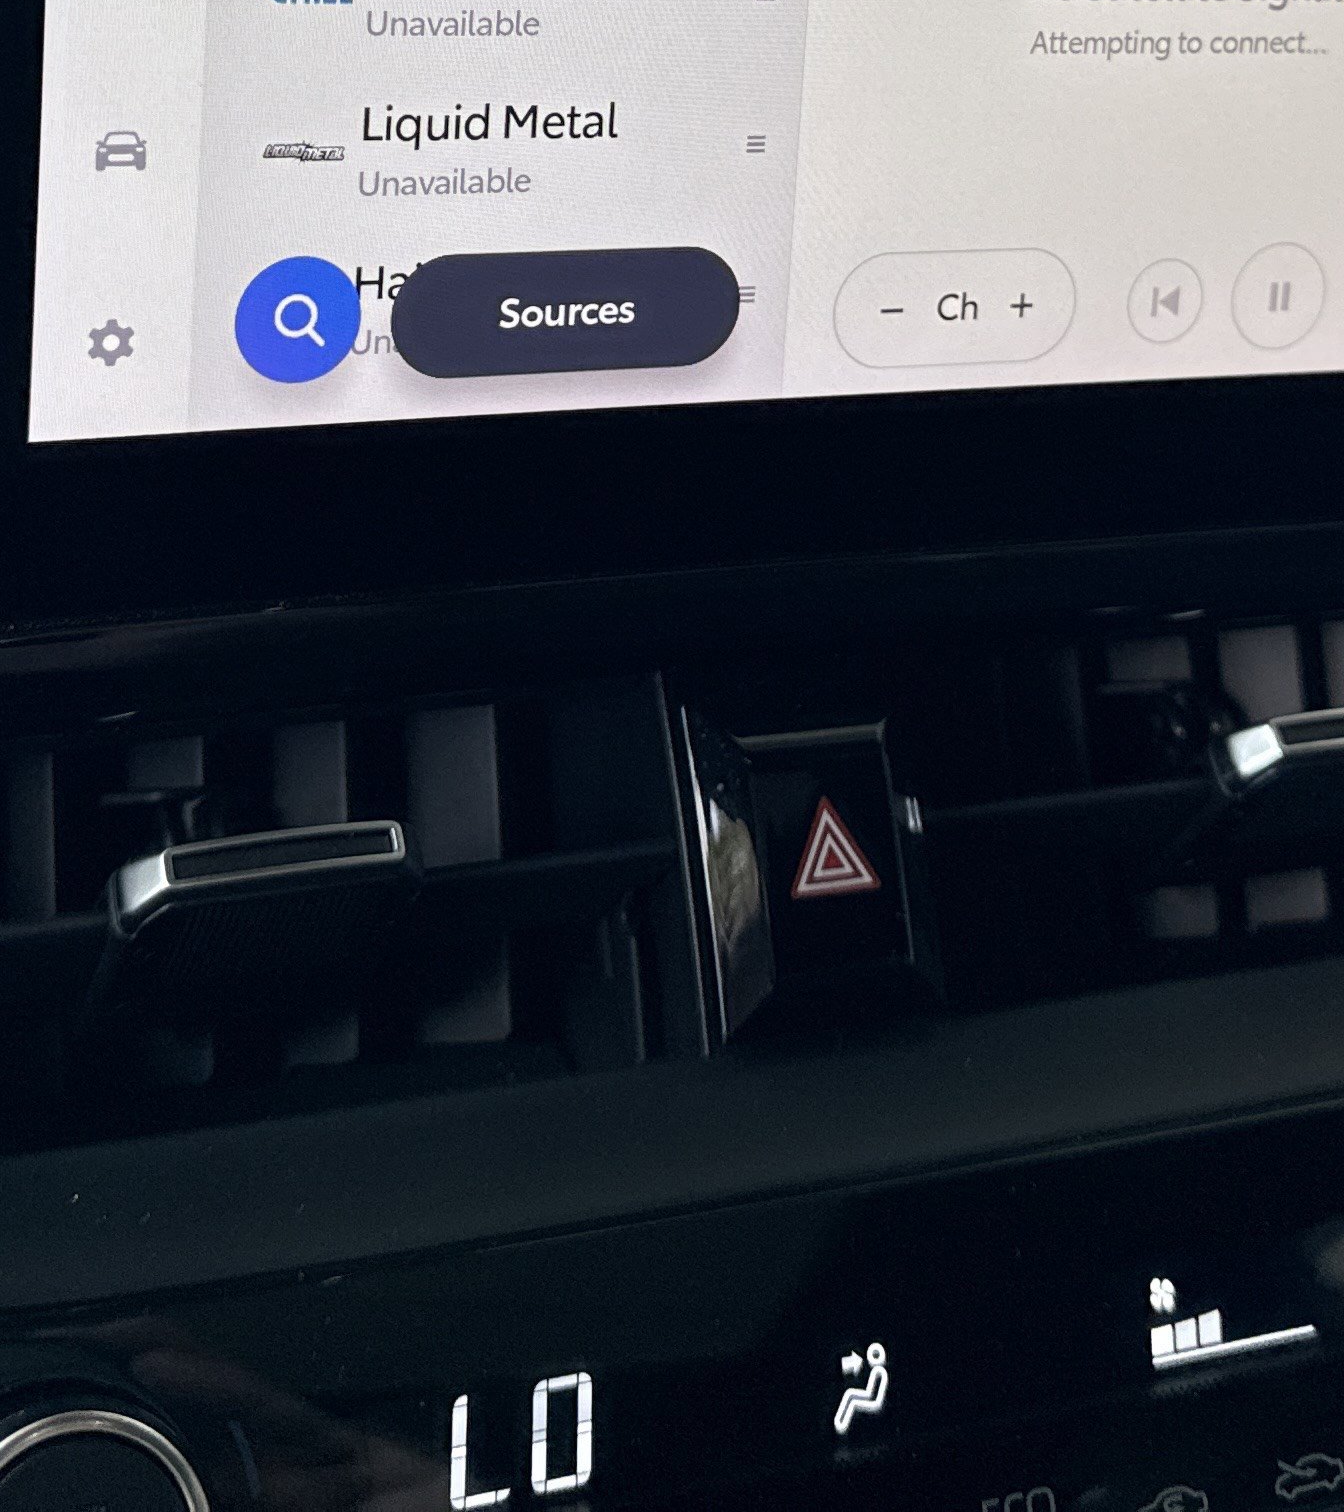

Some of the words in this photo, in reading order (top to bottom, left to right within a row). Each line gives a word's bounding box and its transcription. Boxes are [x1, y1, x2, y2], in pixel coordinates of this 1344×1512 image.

[367, 10, 540, 36] Unavailable
[1030, 30, 1171, 61] Attempting
[1178, 32, 1203, 54] to
[1210, 32, 1328, 54] connect...
[363, 103, 490, 150] Liquid
[504, 102, 618, 139] Metal
[359, 167, 531, 196] Unavailable
[500, 298, 635, 328] Sources
[937, 292, 978, 321] Ch
